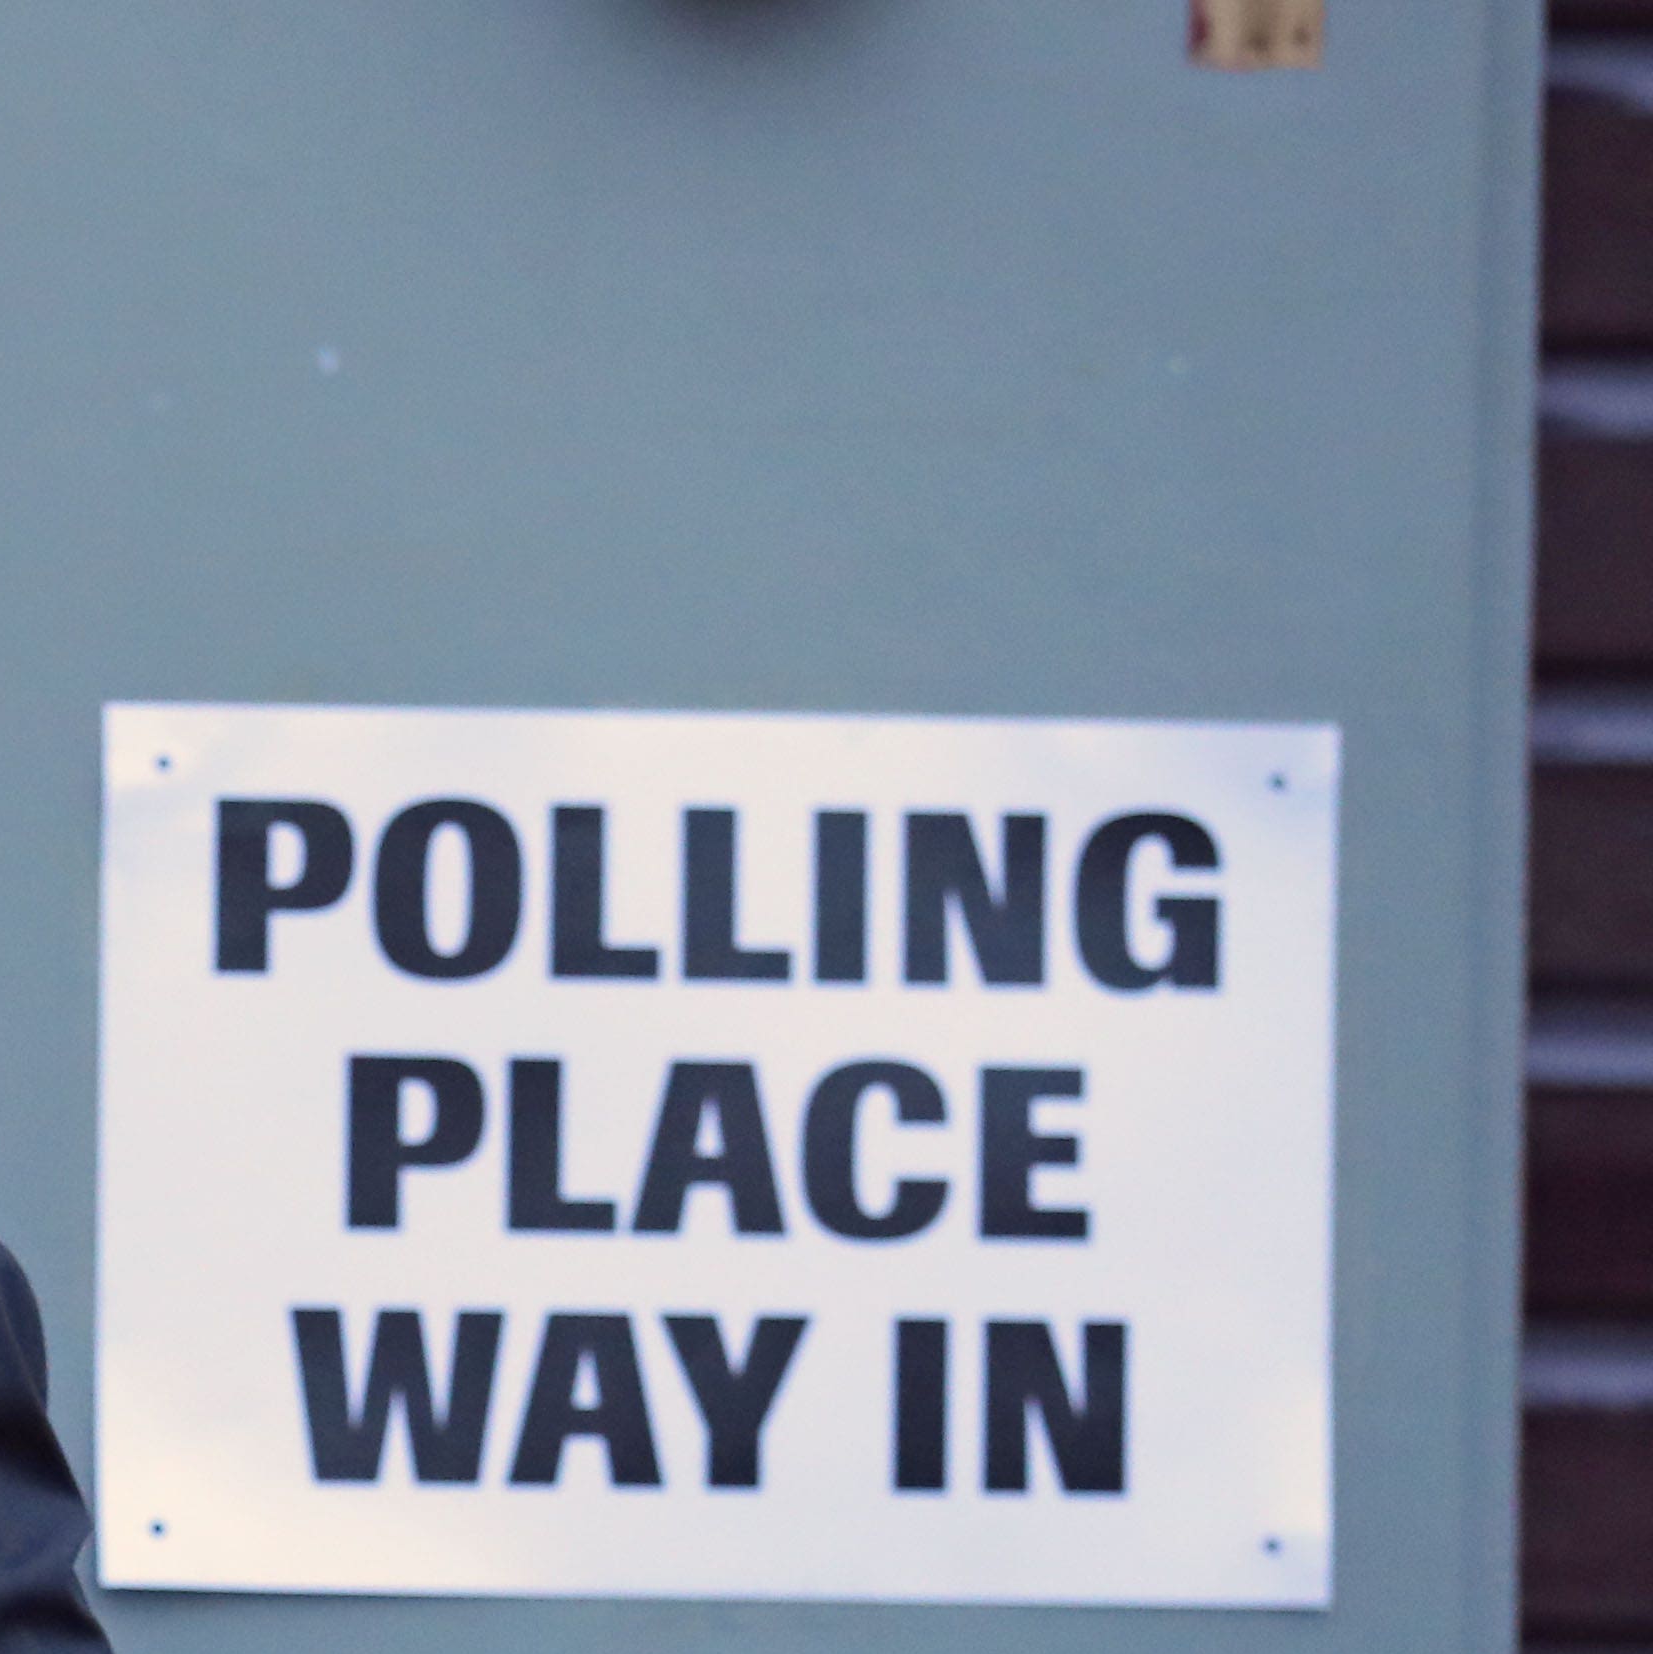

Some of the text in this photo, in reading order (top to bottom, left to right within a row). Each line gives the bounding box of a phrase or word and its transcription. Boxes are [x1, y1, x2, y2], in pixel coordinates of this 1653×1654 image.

[214, 797, 1222, 994] POLLING
[345, 1053, 1091, 1244] PLACE
[290, 1306, 1129, 1497] WAY IN
